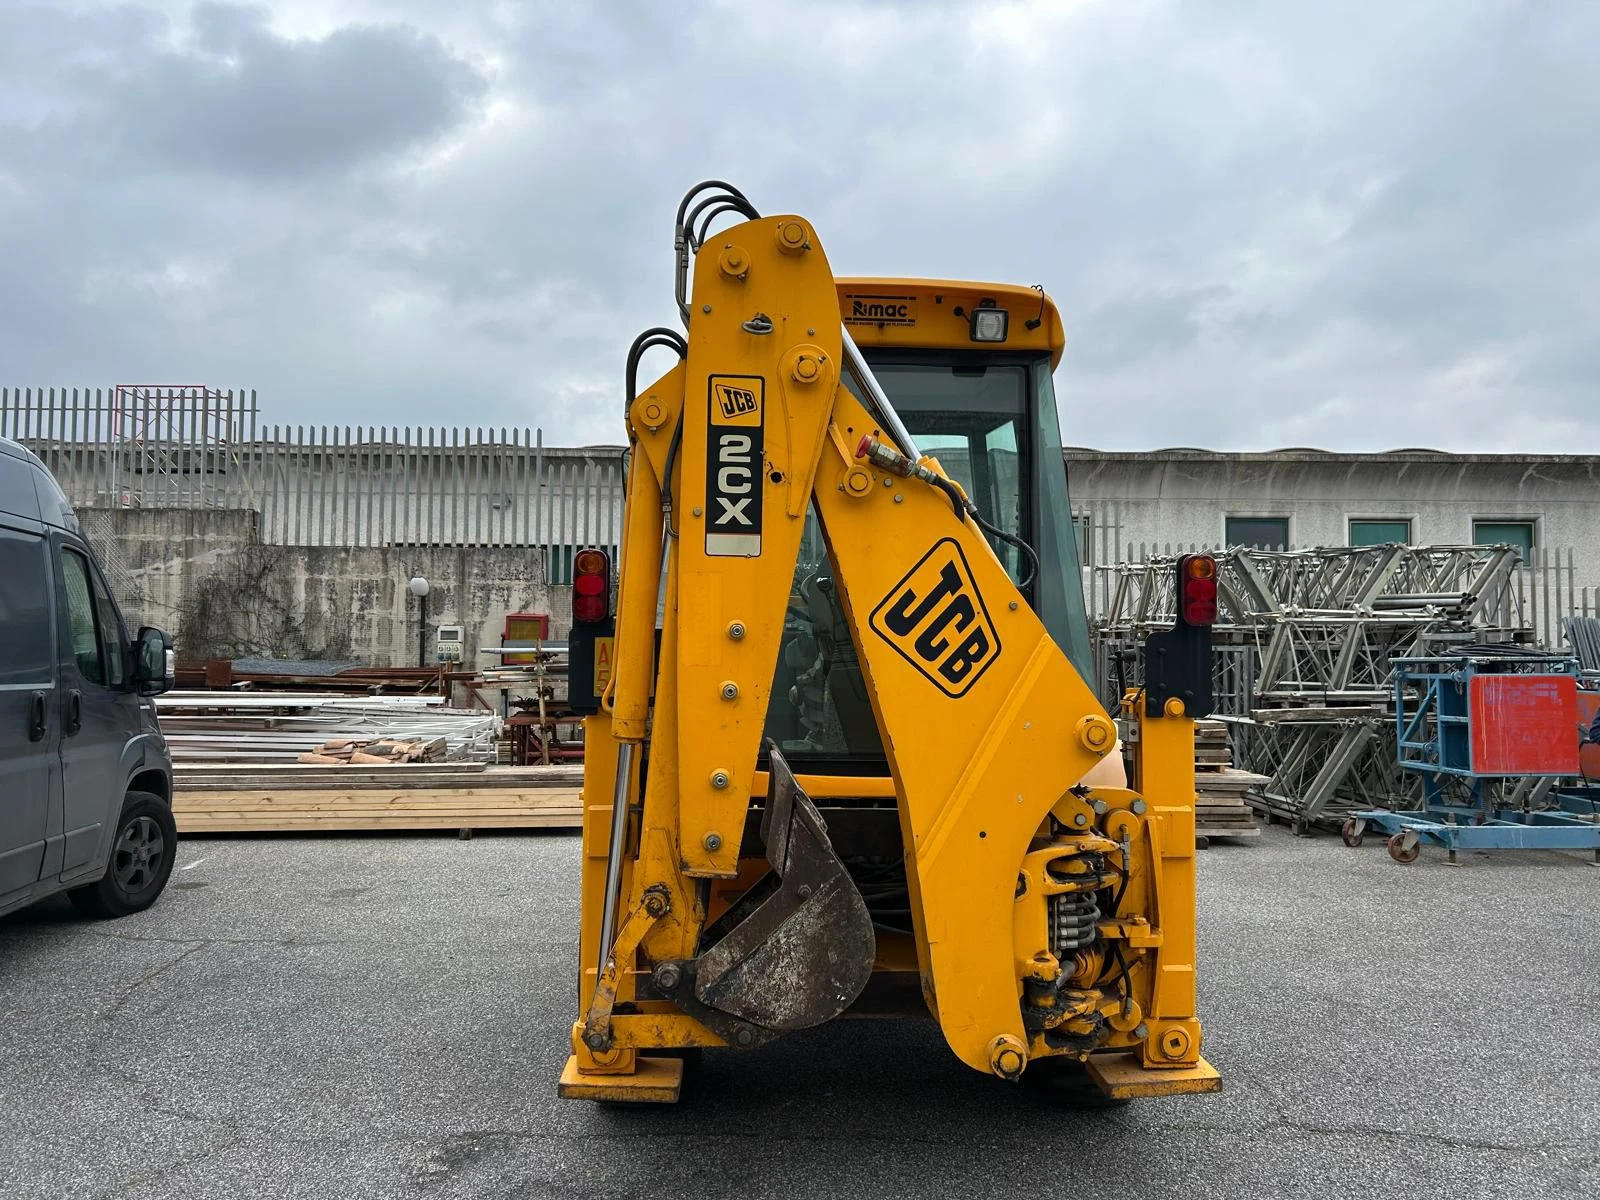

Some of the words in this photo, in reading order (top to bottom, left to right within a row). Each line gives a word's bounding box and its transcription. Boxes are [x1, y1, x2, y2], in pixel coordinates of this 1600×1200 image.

[853, 300, 908, 317] Rimac
[722, 388, 755, 415] JCB
[714, 434, 753, 525] 2CX
[884, 559, 990, 685] JCB
